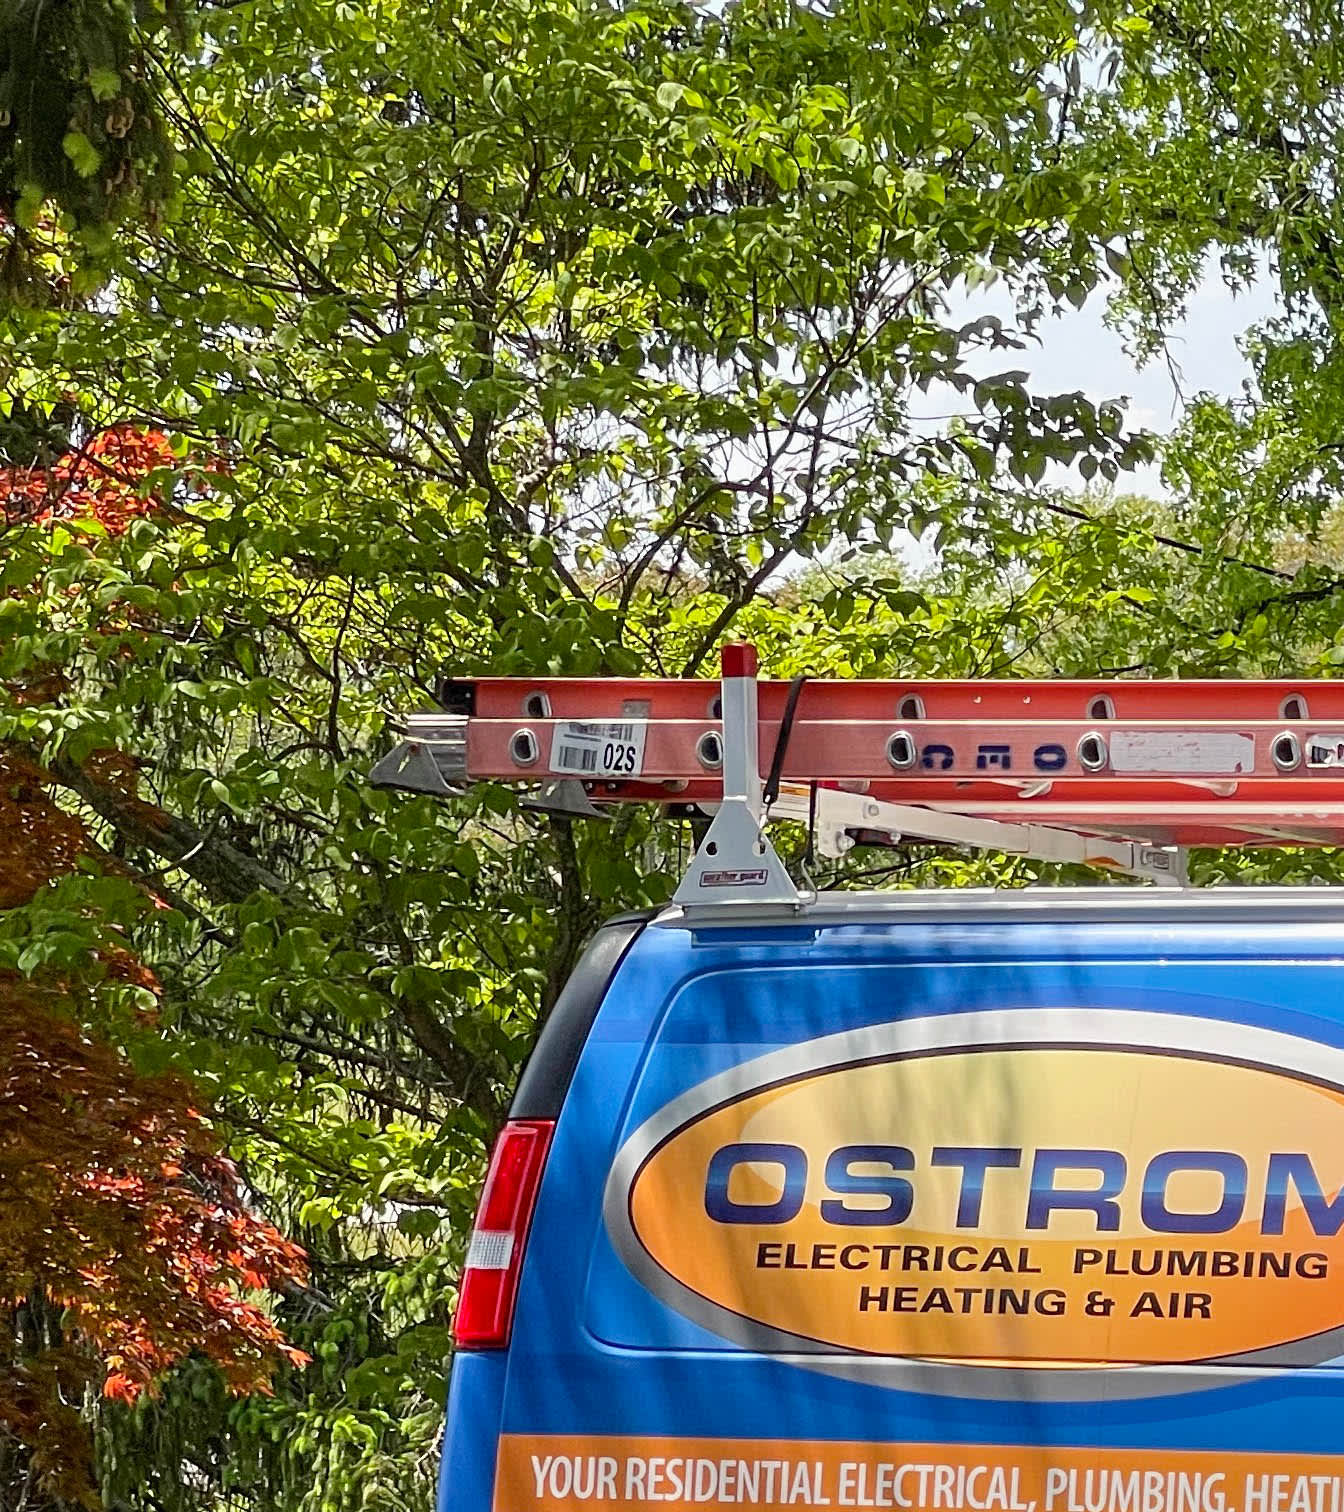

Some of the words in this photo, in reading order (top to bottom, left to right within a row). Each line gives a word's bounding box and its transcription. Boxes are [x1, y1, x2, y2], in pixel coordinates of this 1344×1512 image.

[755, 1243, 1042, 1275] ELECTRICAL
[1073, 1247, 1329, 1280] PLUMBING
[857, 1286, 1067, 1317] HEATING
[1084, 1291, 1115, 1317] &
[1130, 1291, 1213, 1319] AIR
[530, 1455, 618, 1500] YOUR
[624, 1456, 831, 1506] RESIDENTIAL
